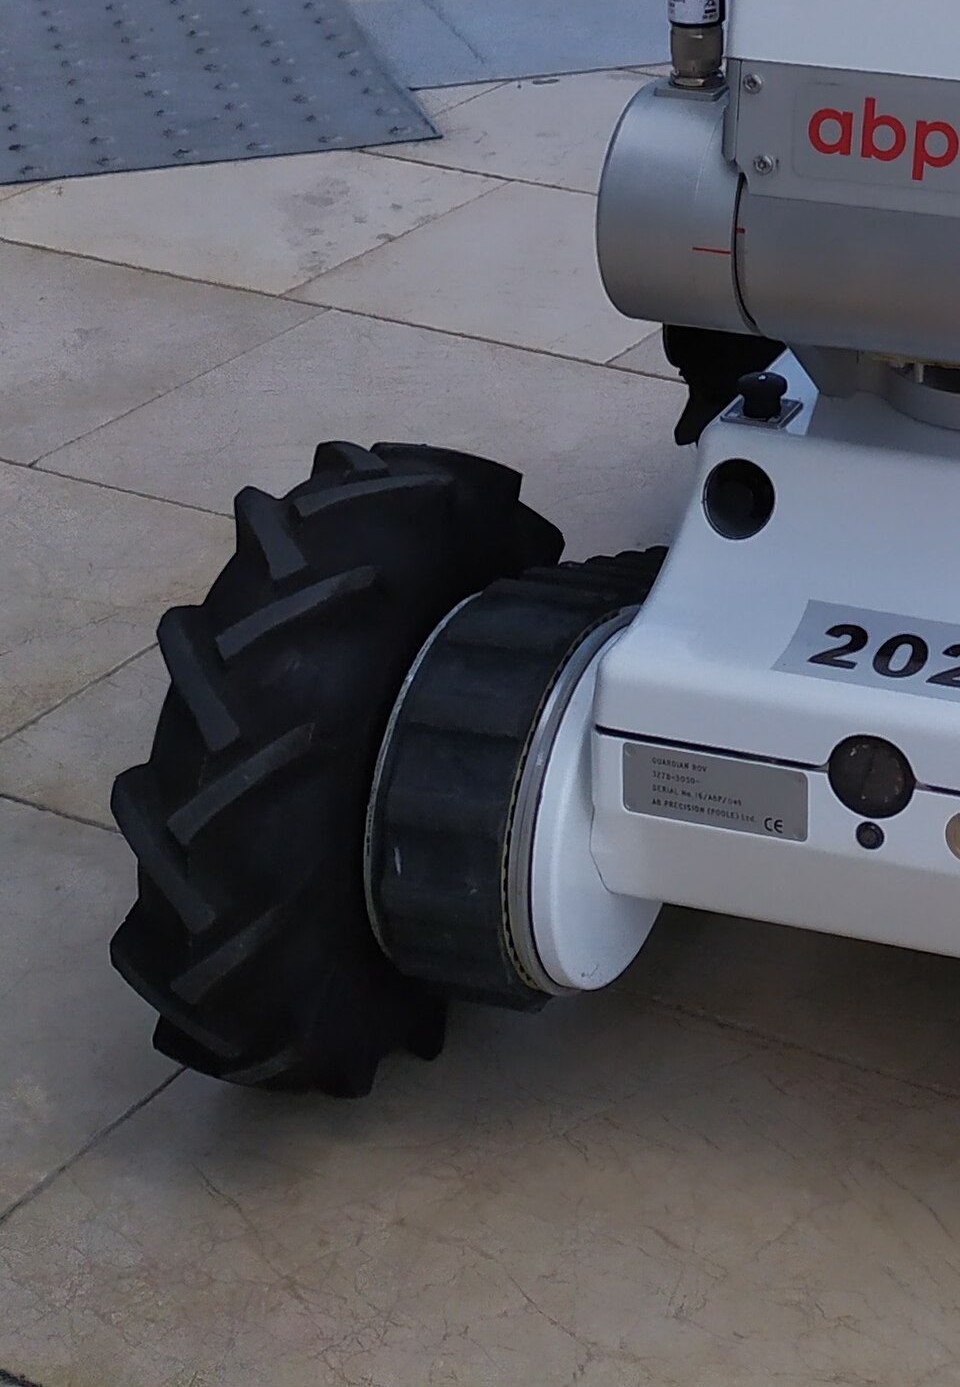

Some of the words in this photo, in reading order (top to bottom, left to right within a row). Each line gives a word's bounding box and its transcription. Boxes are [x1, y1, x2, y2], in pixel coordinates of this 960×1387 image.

[807, 95, 960, 181] abp
[651, 757, 689, 769] GUARDIAN
[692, 764, 708, 773] ROV
[651, 784, 679, 796] SERIAL
[651, 797, 662, 806] AB
[663, 799, 705, 815] PRECISION
[707, 807, 740, 820] (POOLE)
[764, 817, 784, 834] CE
